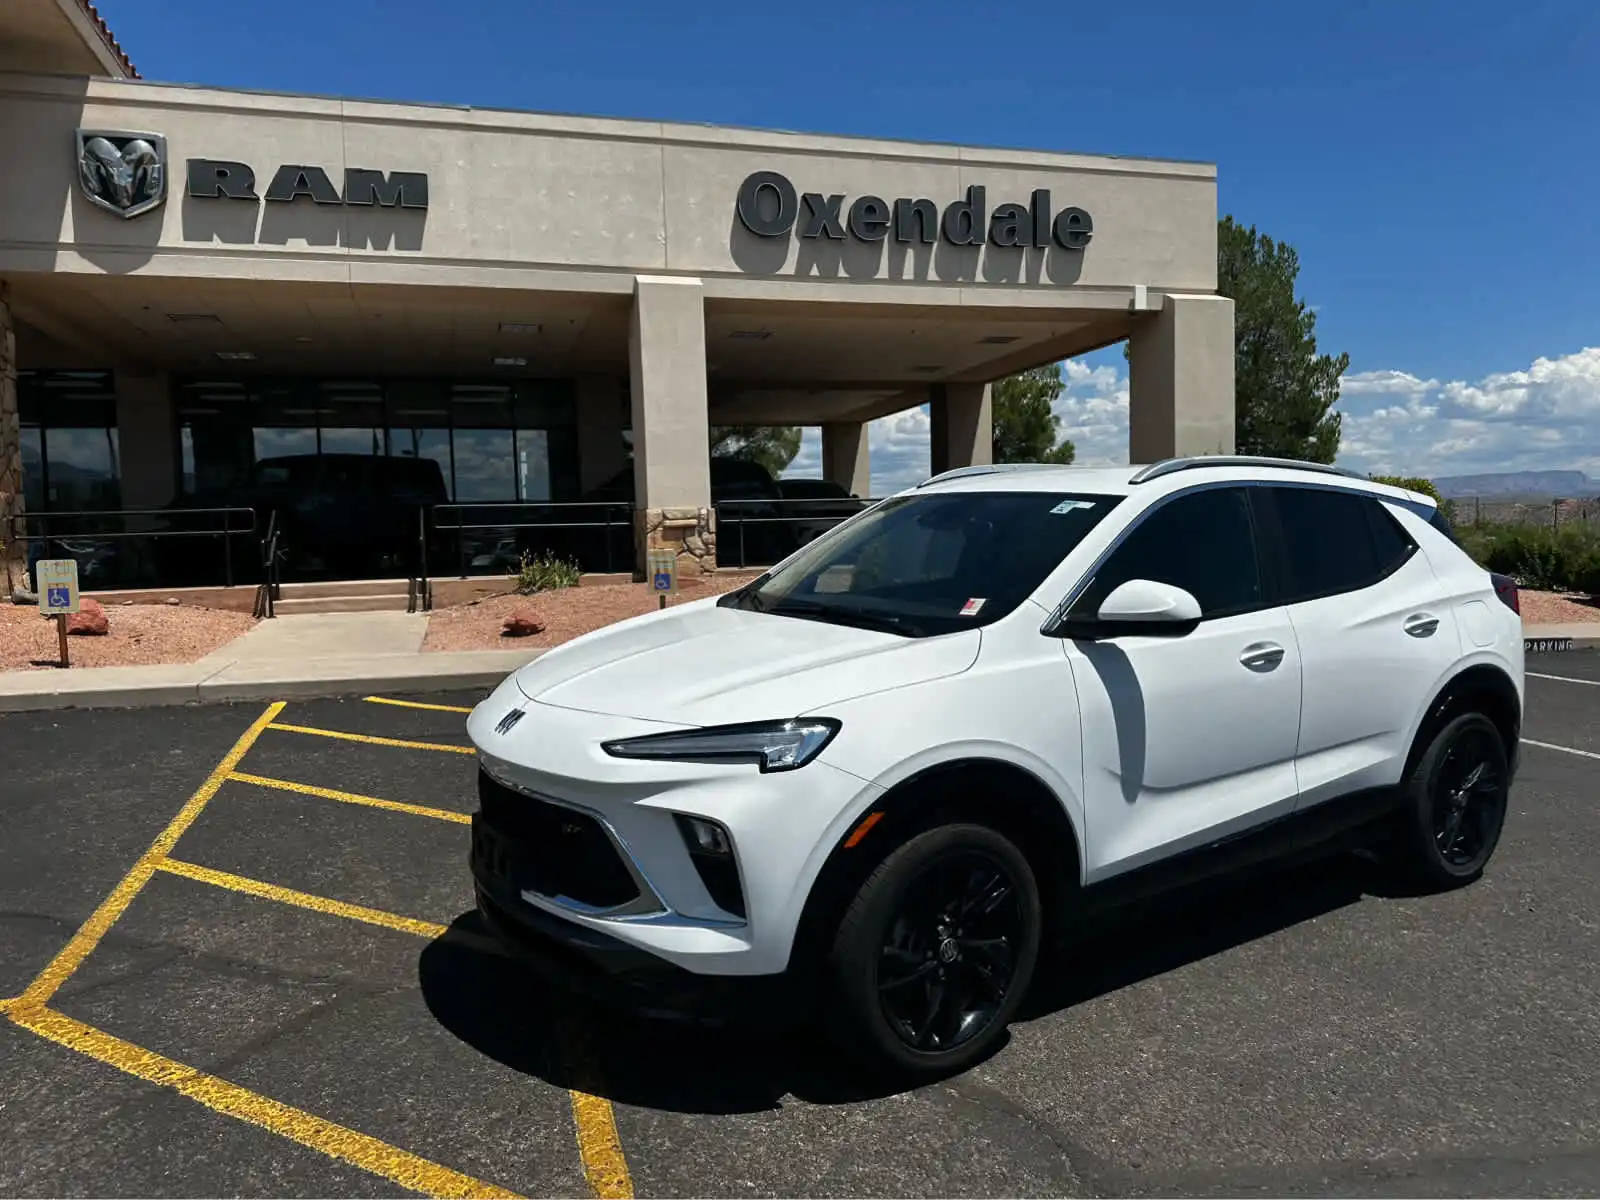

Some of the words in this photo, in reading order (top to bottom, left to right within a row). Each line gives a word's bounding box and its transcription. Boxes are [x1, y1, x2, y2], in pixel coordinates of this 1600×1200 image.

[186, 158, 428, 208] RAM
[736, 170, 1094, 250] Oxendale
[1524, 639, 1574, 652] PARKING
